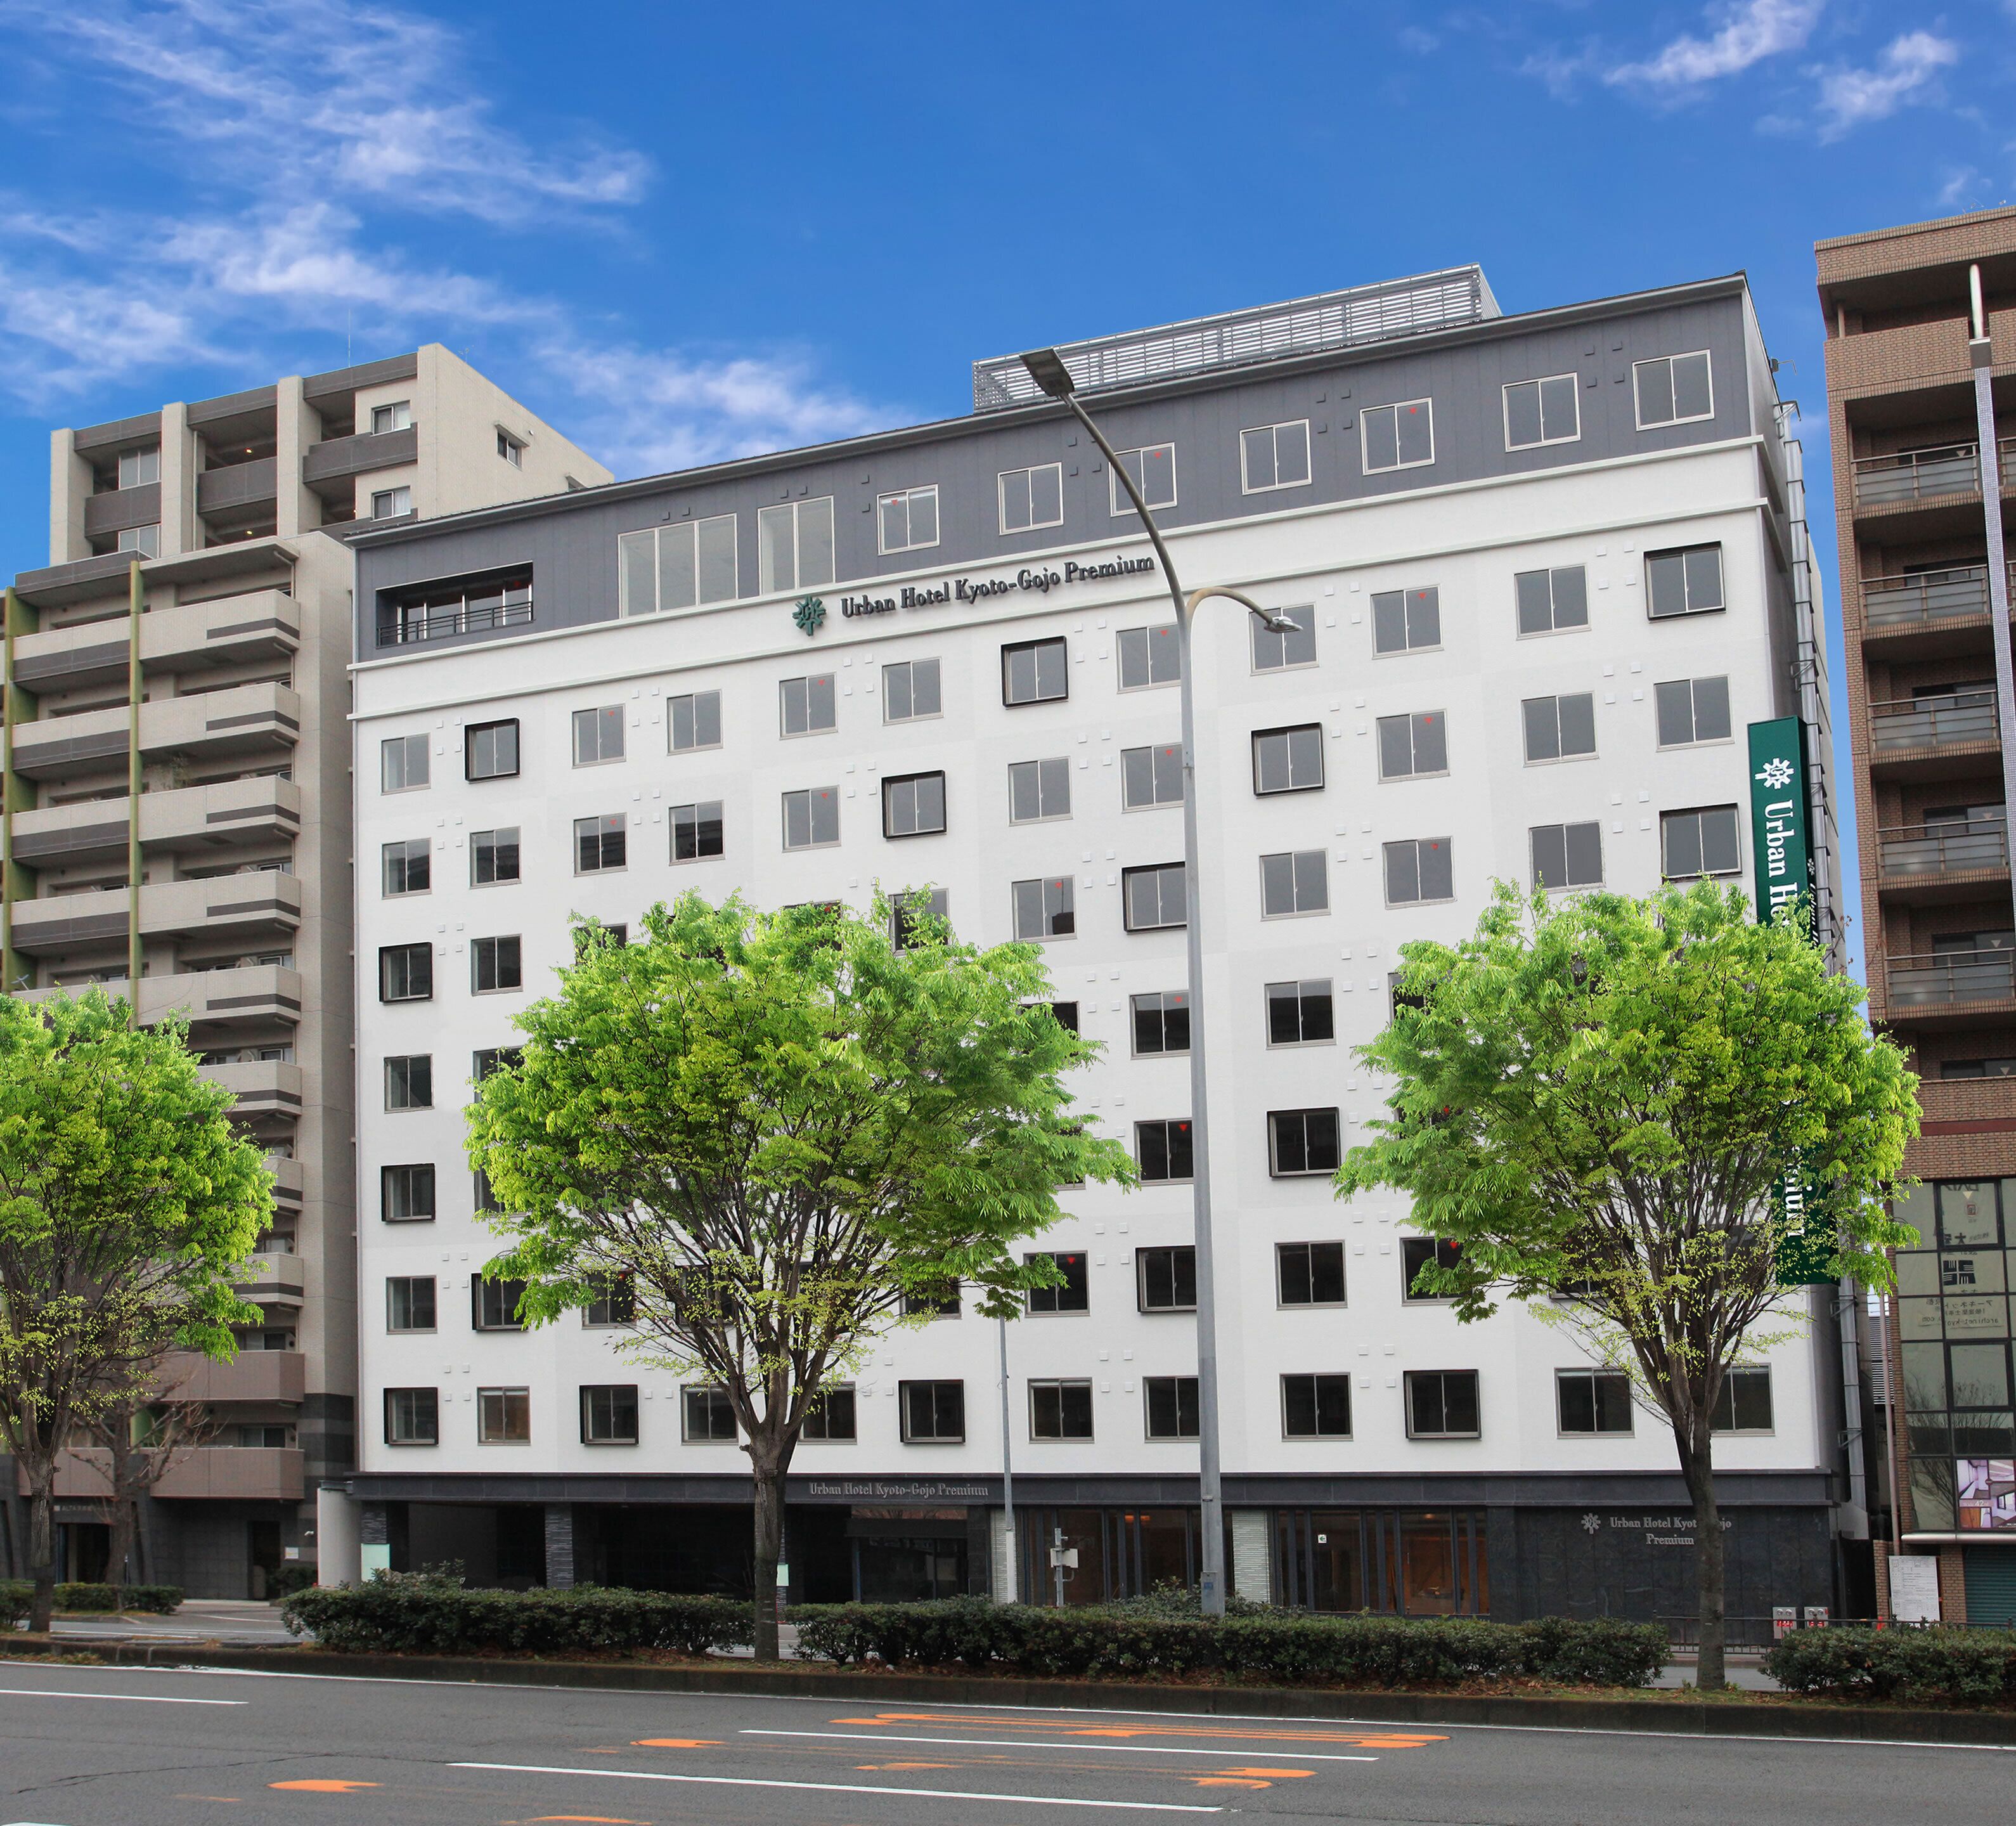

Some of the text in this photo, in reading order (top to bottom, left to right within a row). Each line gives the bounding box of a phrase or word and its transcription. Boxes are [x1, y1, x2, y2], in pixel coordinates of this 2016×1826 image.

[841, 555, 1155, 618] Urban Hotel Kyoto-Gojo Premium
[1765, 800, 1795, 877] Urban
[809, 1482, 989, 1499] Urban Hotel Kyoto-Gojo Premium
[1609, 1517, 1732, 1531] Urban Hotel Kyotjo
[1646, 1534, 1695, 1545] Premium
